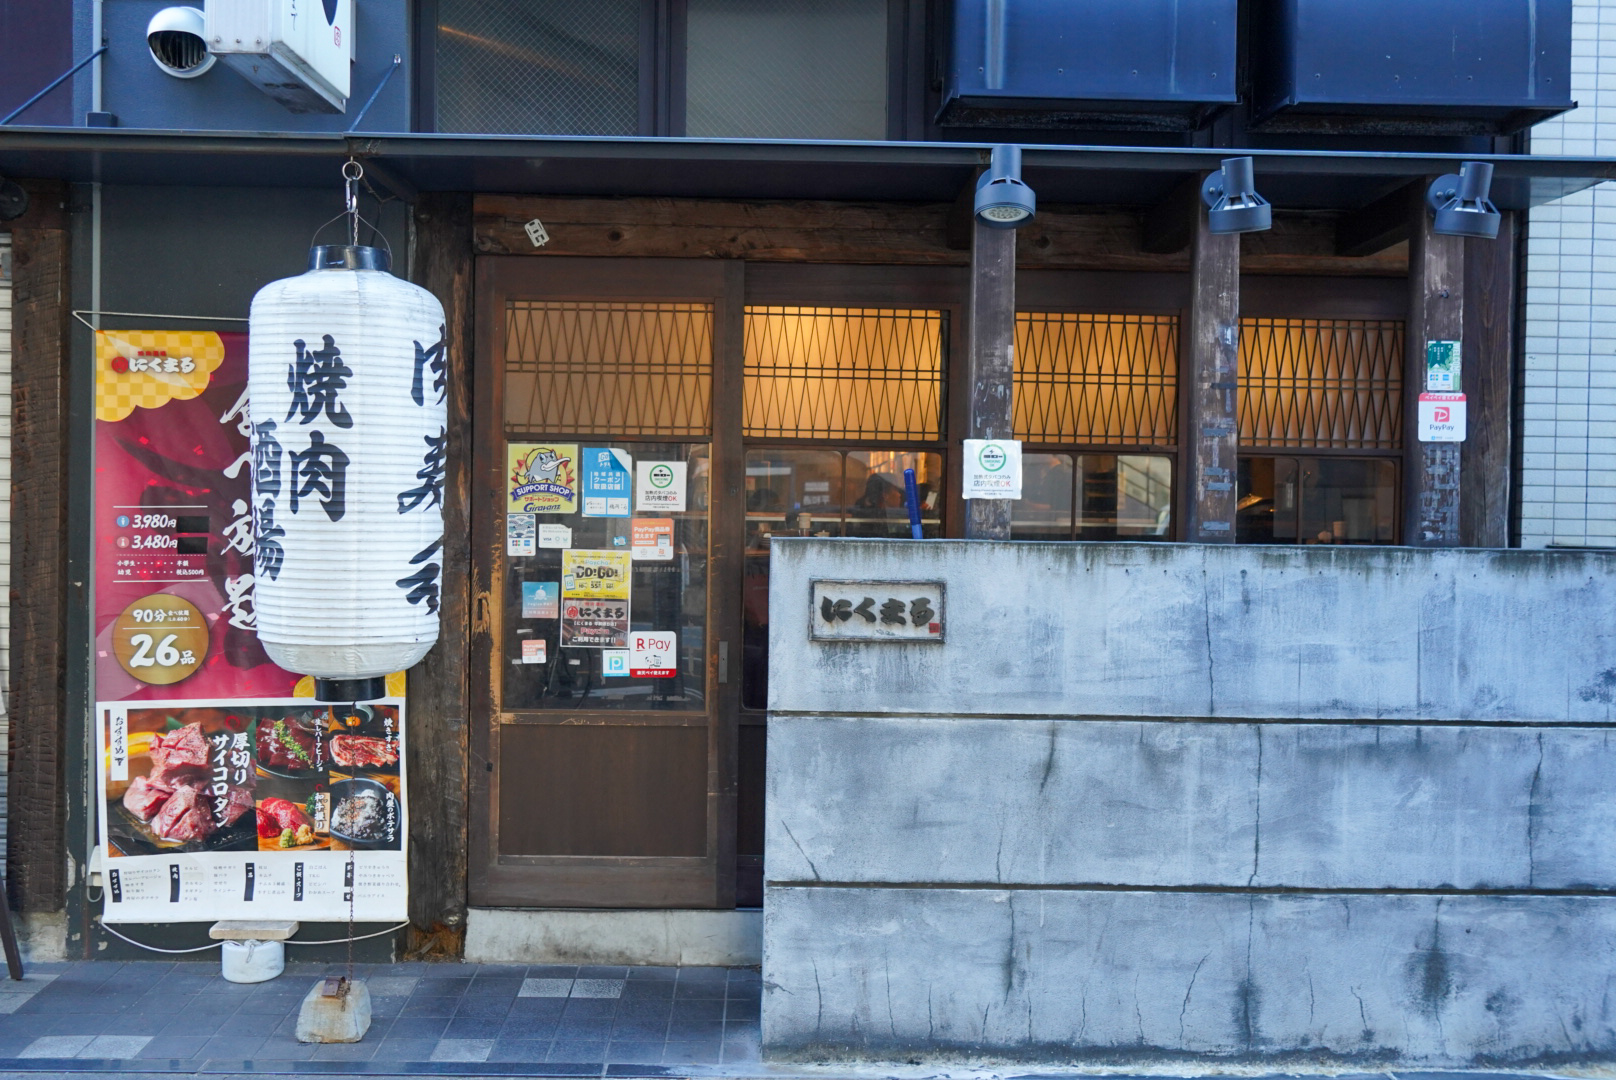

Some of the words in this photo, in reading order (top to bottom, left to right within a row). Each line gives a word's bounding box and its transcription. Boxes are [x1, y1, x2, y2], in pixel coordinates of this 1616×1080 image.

[129, 357, 195, 373] にくまる
[284, 333, 354, 522] 焼肉
[1429, 424, 1455, 432] PayPay
[516, 484, 549, 496] SUPPORT
[549, 484, 570, 496] SHOP
[132, 514, 177, 529] 3,980円
[131, 535, 178, 549] 3,480円
[132, 609, 167, 622] 90分
[579, 607, 625, 619] にくまる
[820, 596, 935, 627] にくまる
[129, 633, 196, 668] 26品
[648, 638, 671, 651] Pay
[114, 716, 124, 754] おすすめ
[314, 718, 324, 772] 生レバーアヒージョ
[230, 732, 251, 786] 厚切り
[212, 734, 229, 828] サイコロタン
[385, 791, 395, 843] 肉屋のポテサラ
